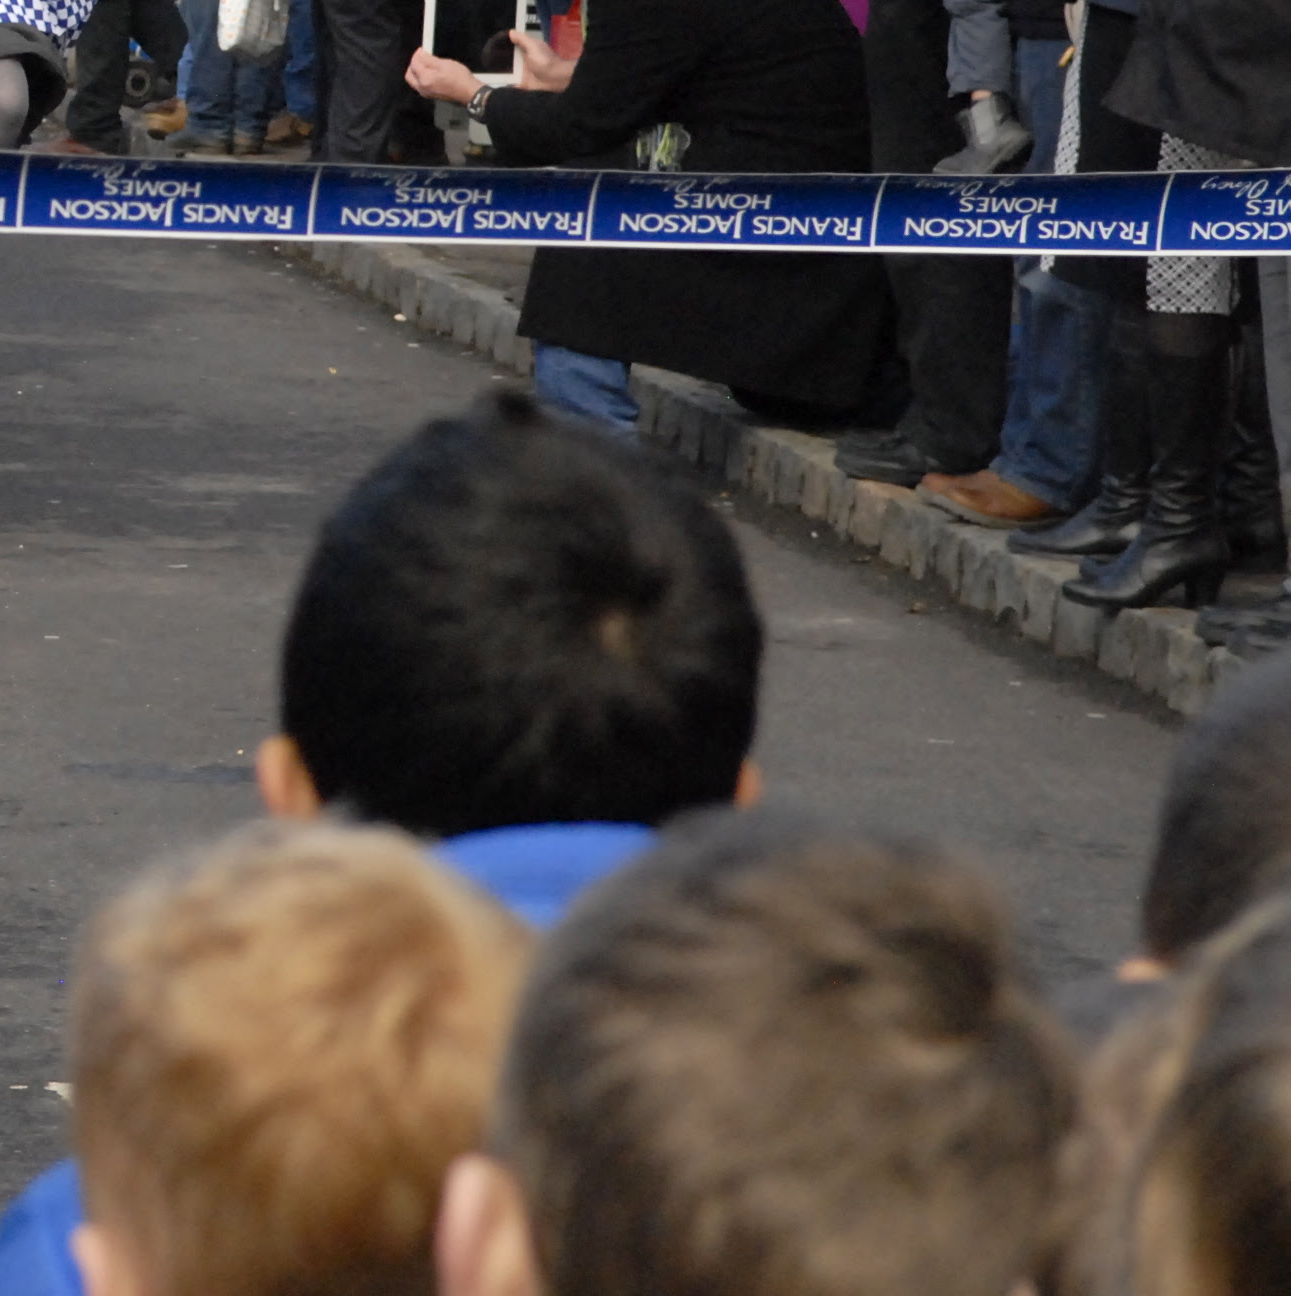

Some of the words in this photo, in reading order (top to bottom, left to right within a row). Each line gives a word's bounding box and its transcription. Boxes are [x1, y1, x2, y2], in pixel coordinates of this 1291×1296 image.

[103, 178, 201, 198] HOMES
[395, 186, 492, 204] HOMES
[1200, 175, 1269, 199] Olney
[49, 197, 175, 227] JACKSON
[673, 192, 771, 210] HOMES
[959, 196, 1057, 213] HOMES
[1245, 198, 1291, 215] MES
[182, 203, 293, 229] FRANCIS
[340, 204, 467, 233] JACKSON
[473, 210, 583, 235] FRANCIS
[619, 209, 745, 239] JACKSON
[752, 215, 862, 240] FRANCIS
[903, 213, 1031, 243] JACKSON
[1037, 220, 1149, 244] FRANCIS
[1190, 221, 1291, 240] CKSON
